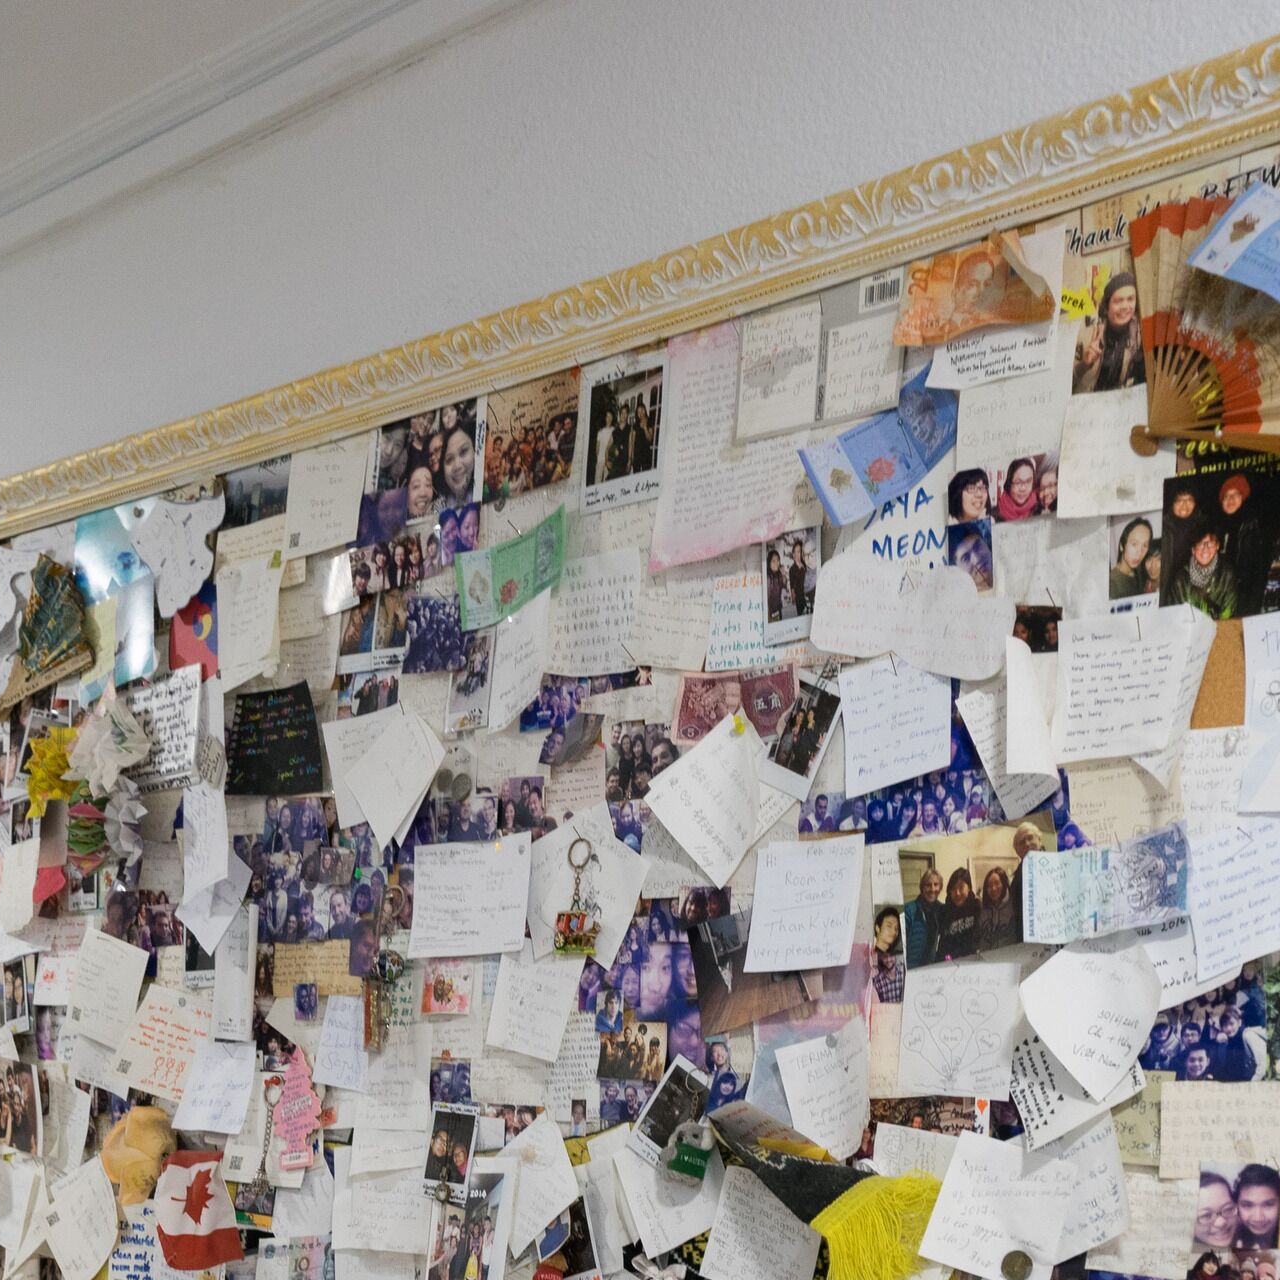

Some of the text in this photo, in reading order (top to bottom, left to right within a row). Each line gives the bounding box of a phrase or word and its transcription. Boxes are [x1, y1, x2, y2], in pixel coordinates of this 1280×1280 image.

[753, 695, 783, 714] 五角
[763, 914, 818, 937] Thank
[1160, 917, 1186, 933] 2016
[293, 1257, 310, 1273] 10
